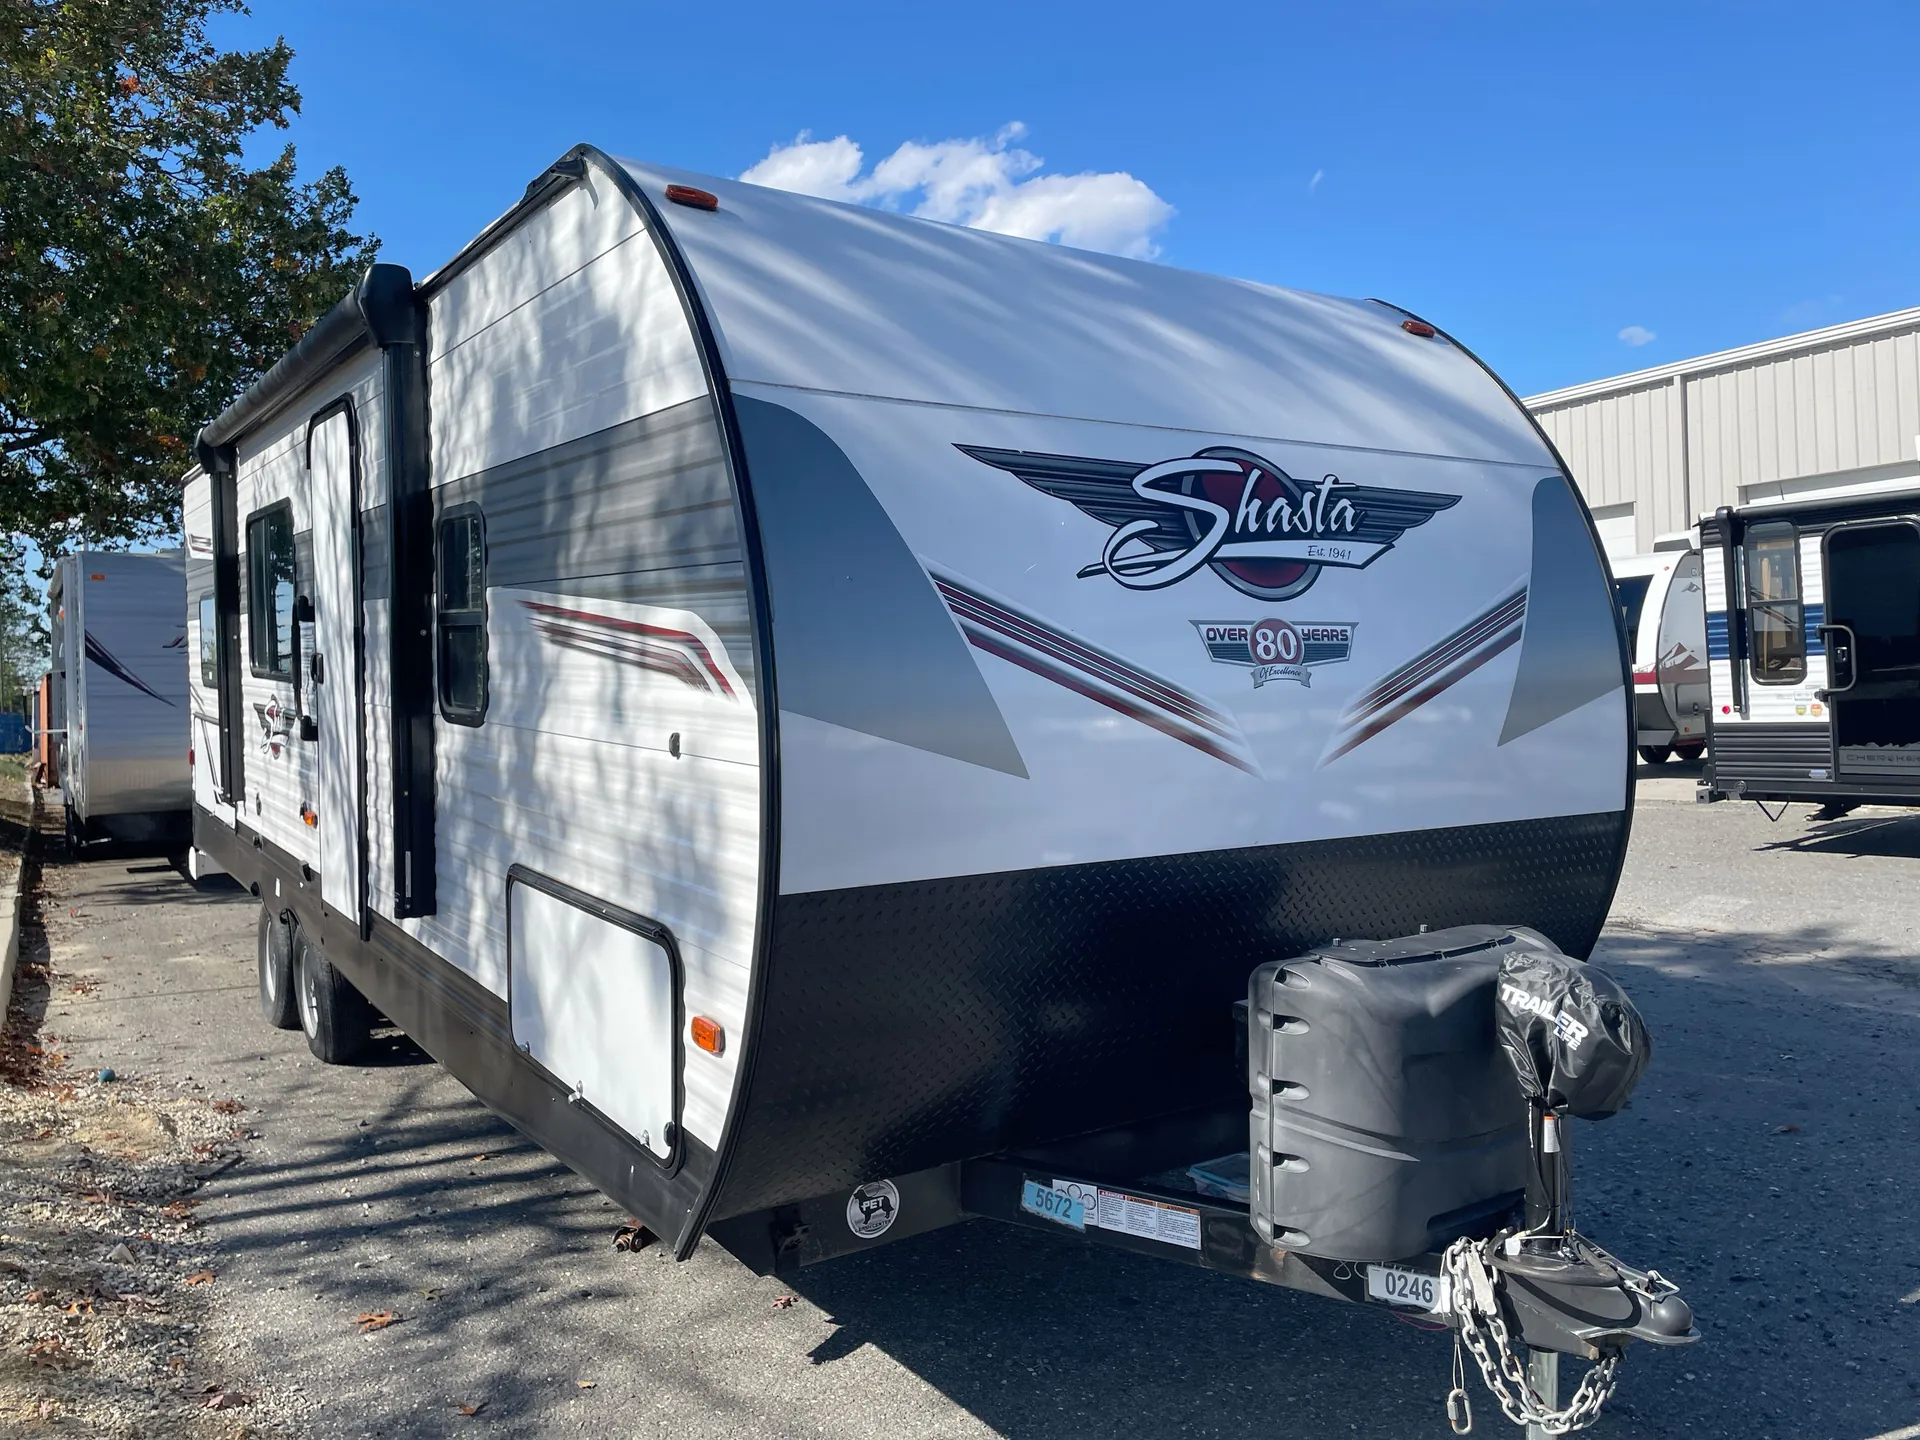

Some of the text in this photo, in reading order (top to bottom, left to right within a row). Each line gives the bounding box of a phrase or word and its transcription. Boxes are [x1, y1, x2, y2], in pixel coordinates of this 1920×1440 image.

[1102, 457, 1359, 590] Shasta
[1307, 545, 1352, 560] Est. 1941
[1206, 628, 1349, 660] OVER 80 YEARS
[1501, 983, 1589, 1042] TRAILER
[1553, 1025, 1581, 1051] LIFE
[861, 1197, 884, 1211] PET
[1035, 1188, 1072, 1219] 5672
[1385, 1271, 1434, 1303] 0246
